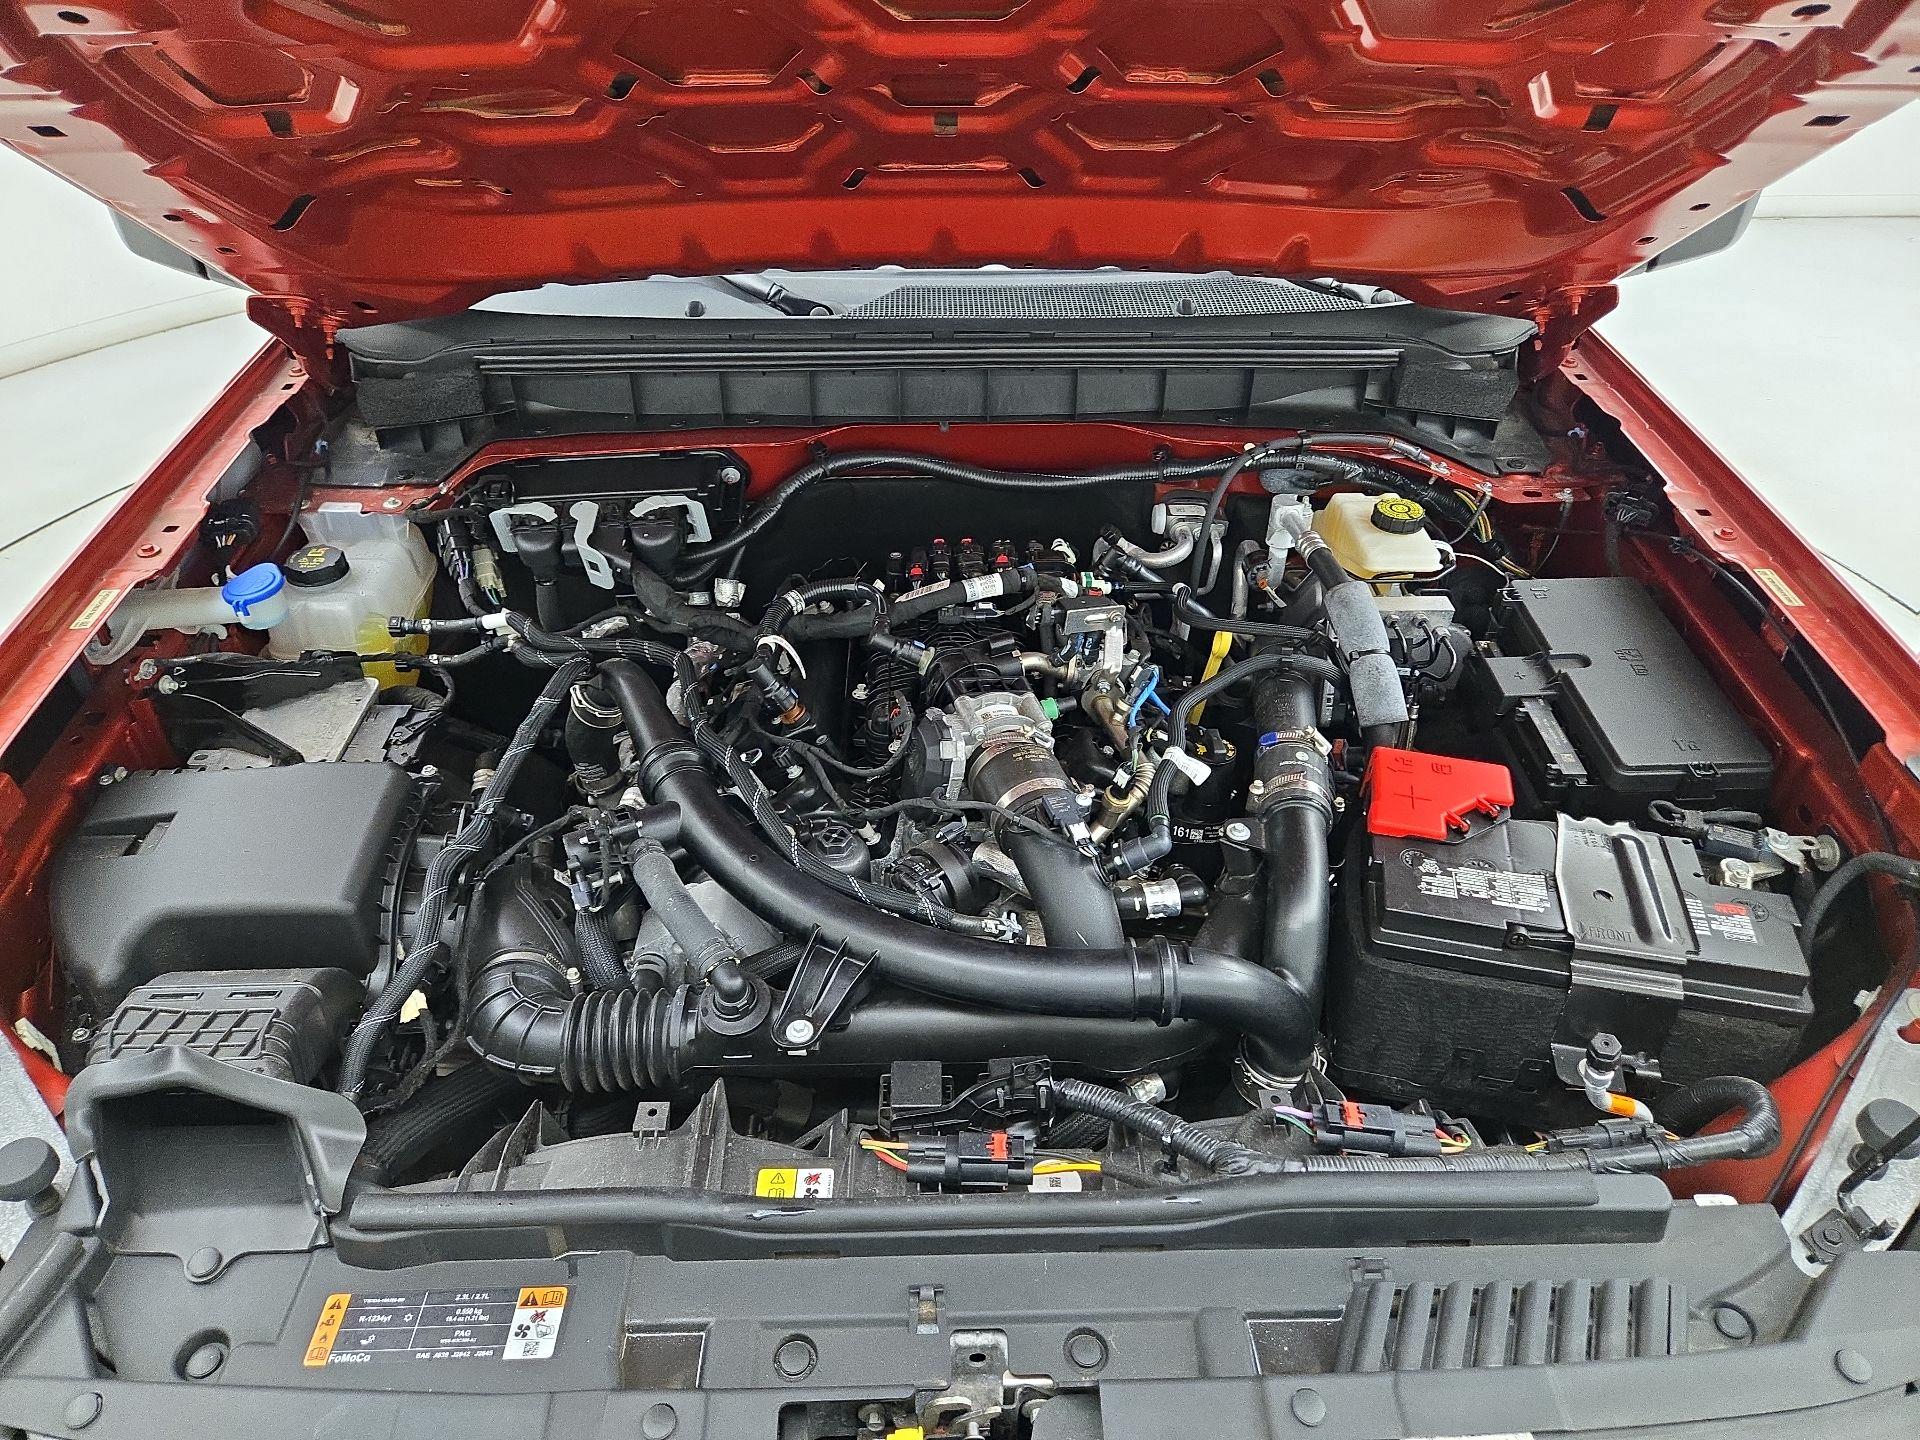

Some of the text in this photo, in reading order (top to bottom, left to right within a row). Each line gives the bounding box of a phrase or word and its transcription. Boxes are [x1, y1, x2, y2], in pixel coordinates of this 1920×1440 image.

[1172, 825, 1190, 838] 161
[1588, 926, 1633, 942] FRONT
[455, 1293, 470, 1301] 2.3L
[475, 1292, 490, 1300] 2.7L
[474, 1308, 483, 1316] kg
[454, 1329, 472, 1337] PAG
[328, 1352, 371, 1363] FoMoCo
